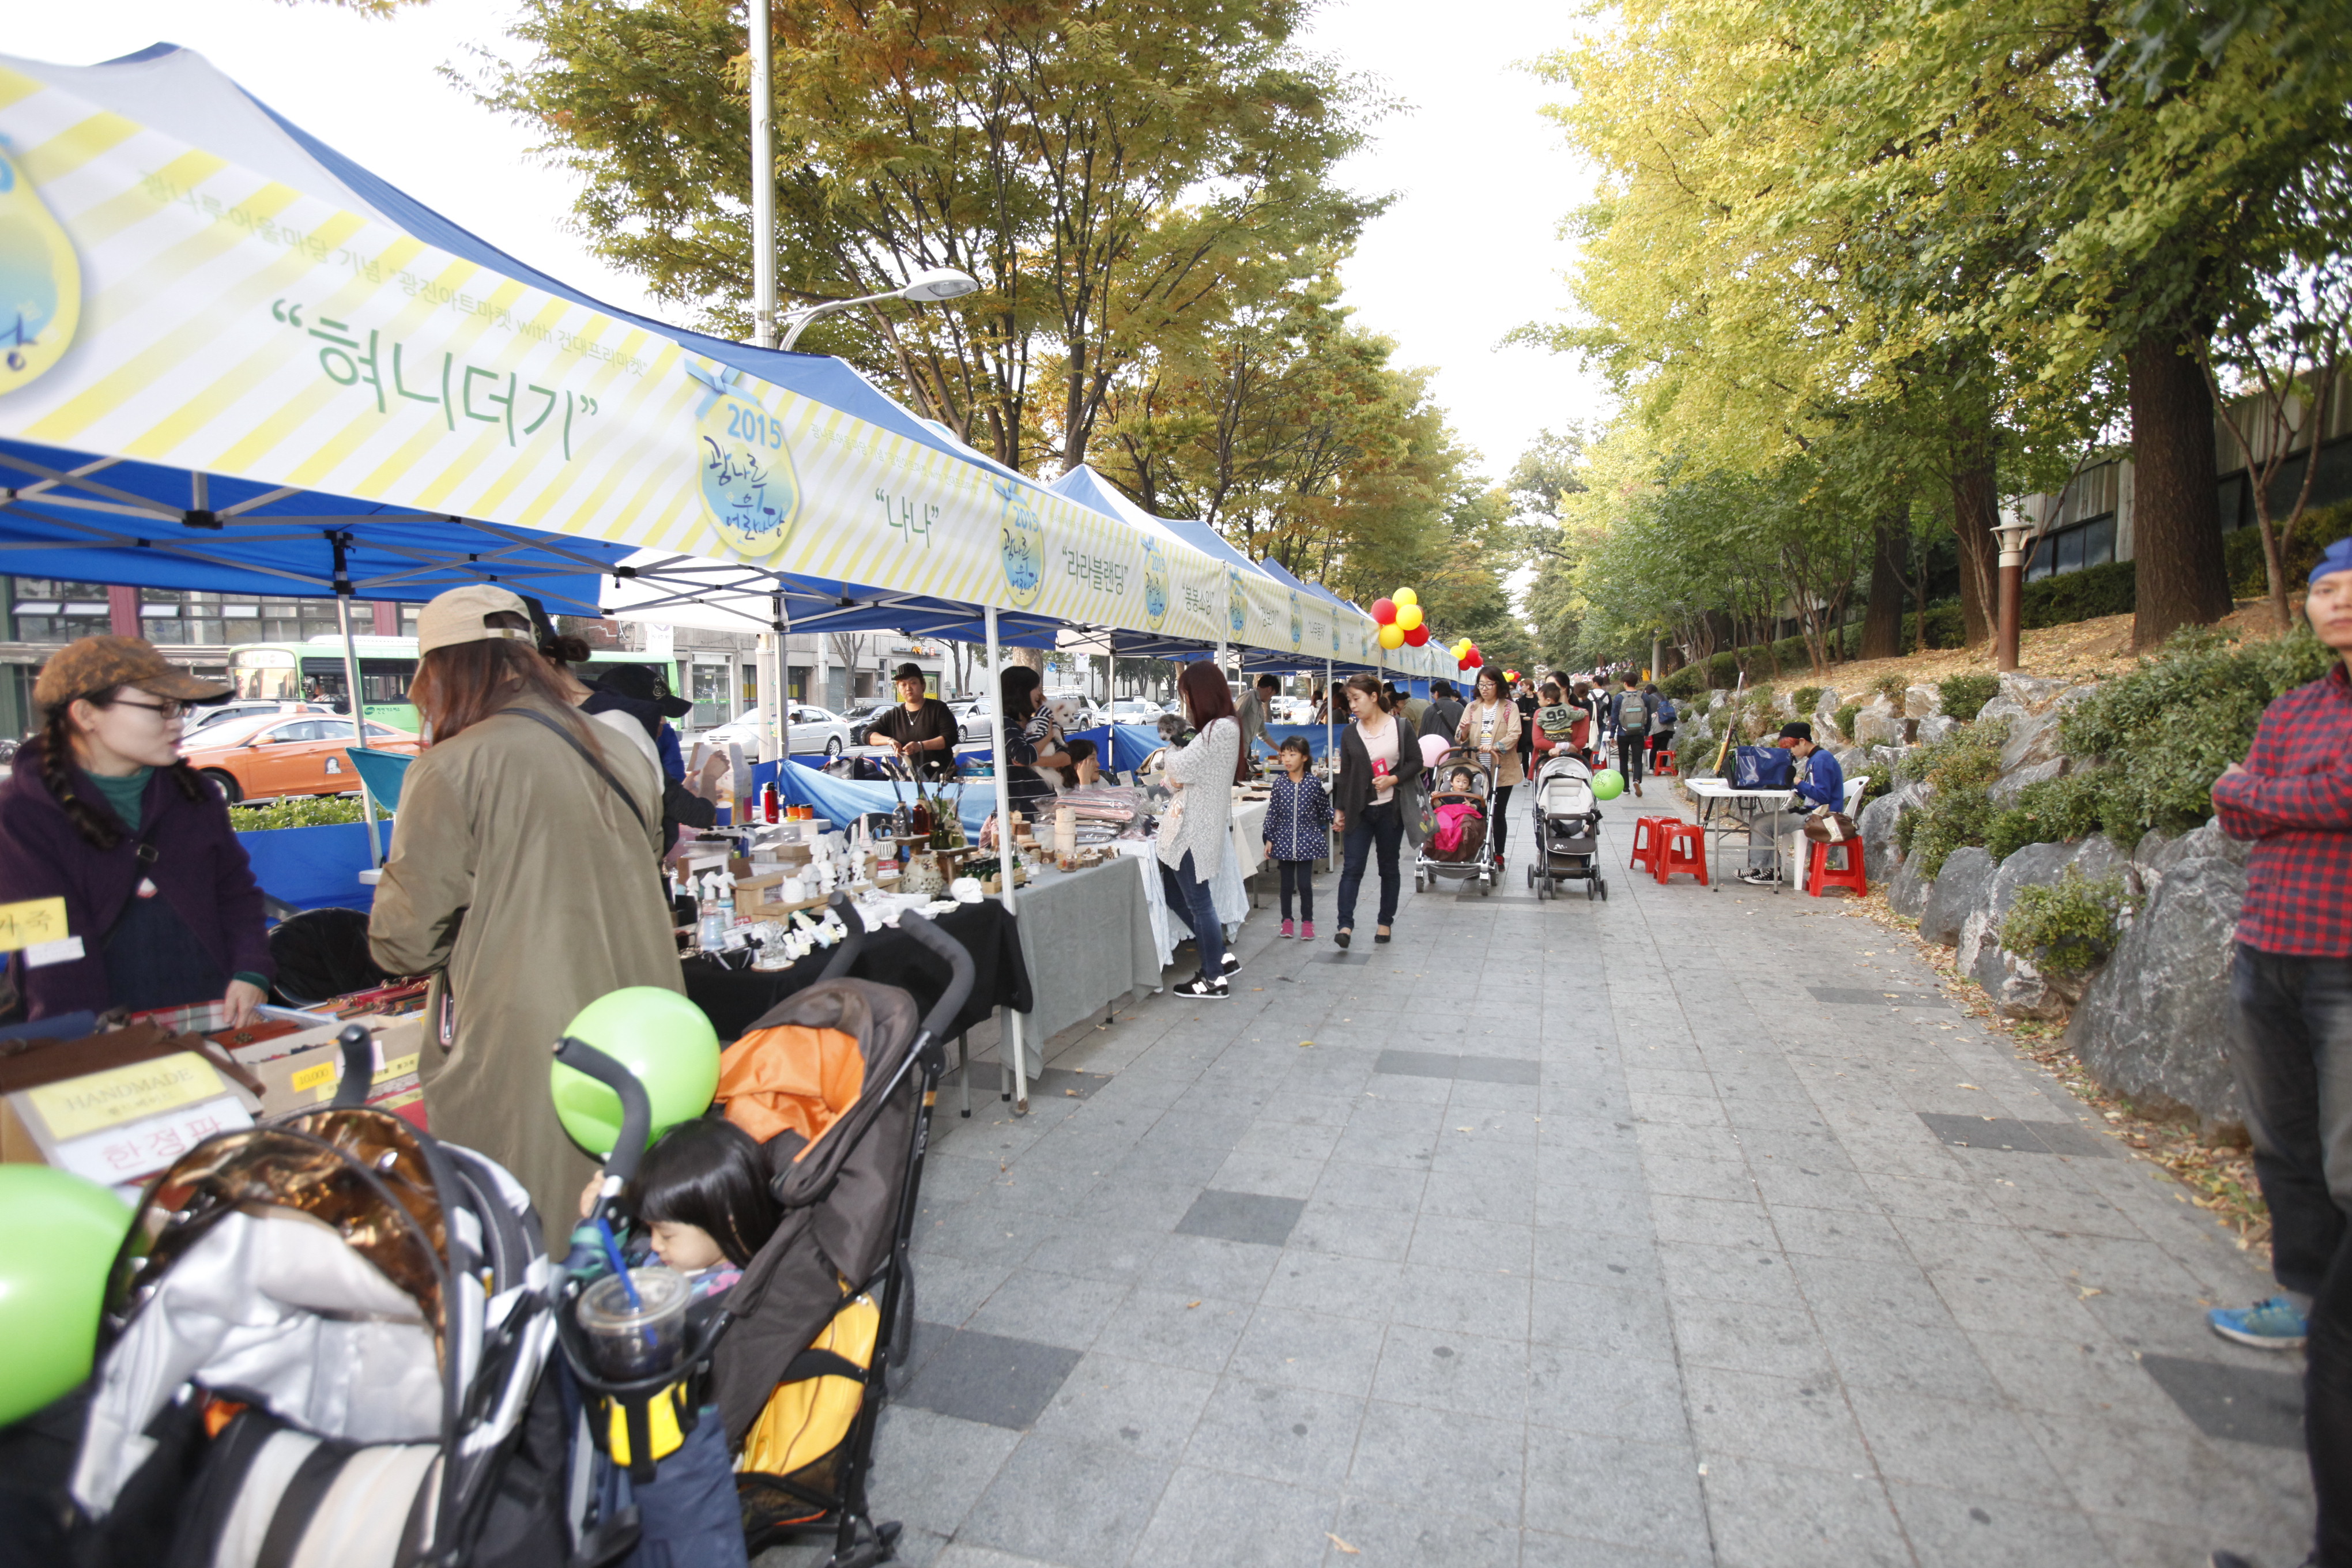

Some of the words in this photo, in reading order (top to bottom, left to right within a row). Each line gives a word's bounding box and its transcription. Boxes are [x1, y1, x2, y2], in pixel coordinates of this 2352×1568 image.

[338, 248, 382, 284] 기념
[389, 267, 512, 330] "광진아트마켓
[518, 319, 552, 343] with
[558, 330, 647, 377] 건대프리마켓"
[728, 404, 782, 450] 2015
[703, 435, 768, 512] 광나루
[876, 488, 939, 548] “나나”
[1013, 506, 1039, 532] 2015
[1546, 708, 1566, 721] 99
[66, 1067, 194, 1111] HANDMADE
[299, 1068, 329, 1085] 10,000
